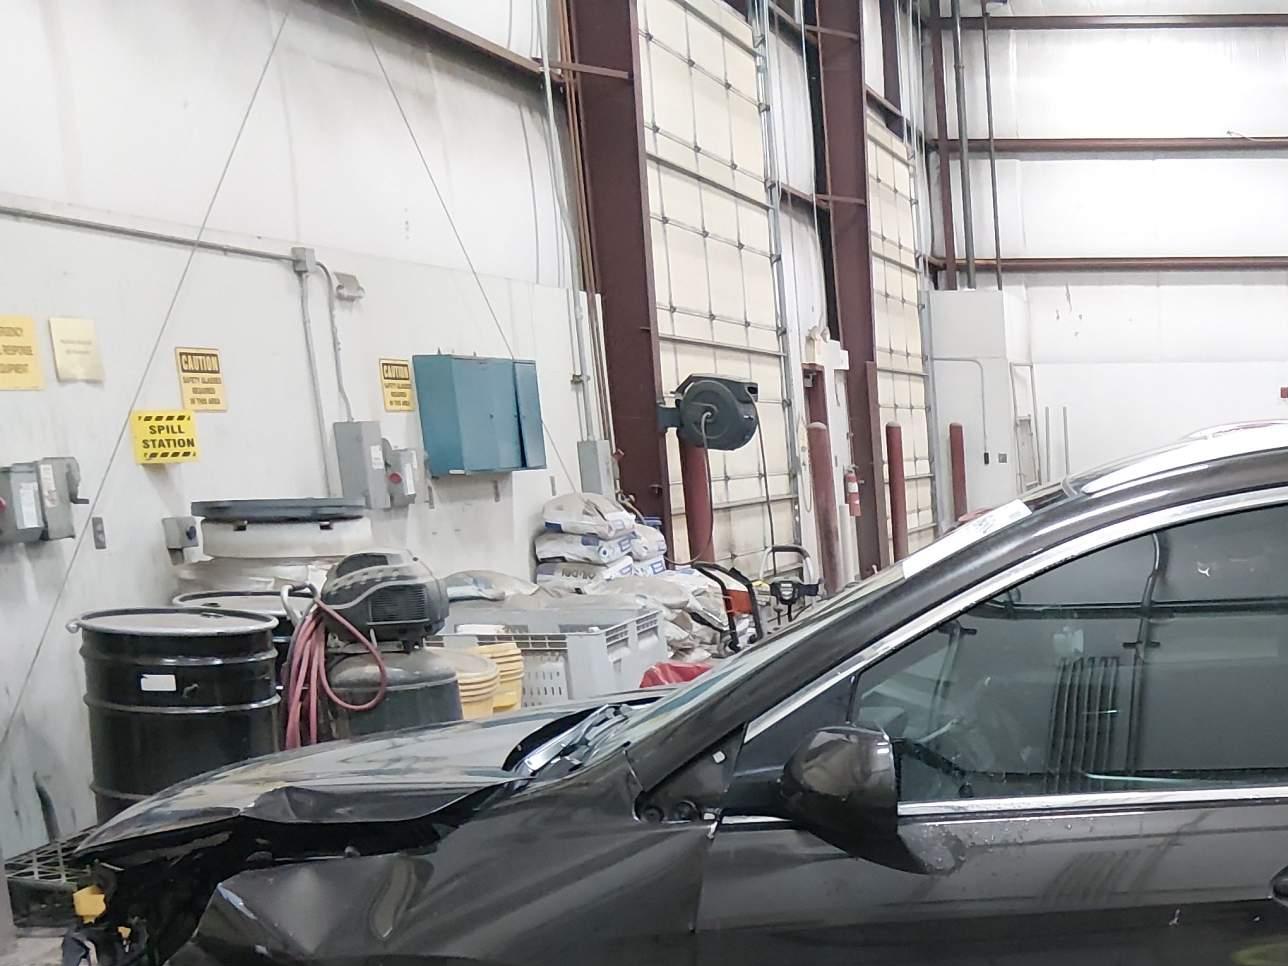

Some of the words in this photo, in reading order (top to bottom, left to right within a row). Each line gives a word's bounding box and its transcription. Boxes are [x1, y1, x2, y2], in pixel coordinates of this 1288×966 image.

[181, 354, 218, 371] CAUTION
[149, 424, 185, 435] SPILL
[142, 438, 195, 449] STATION
